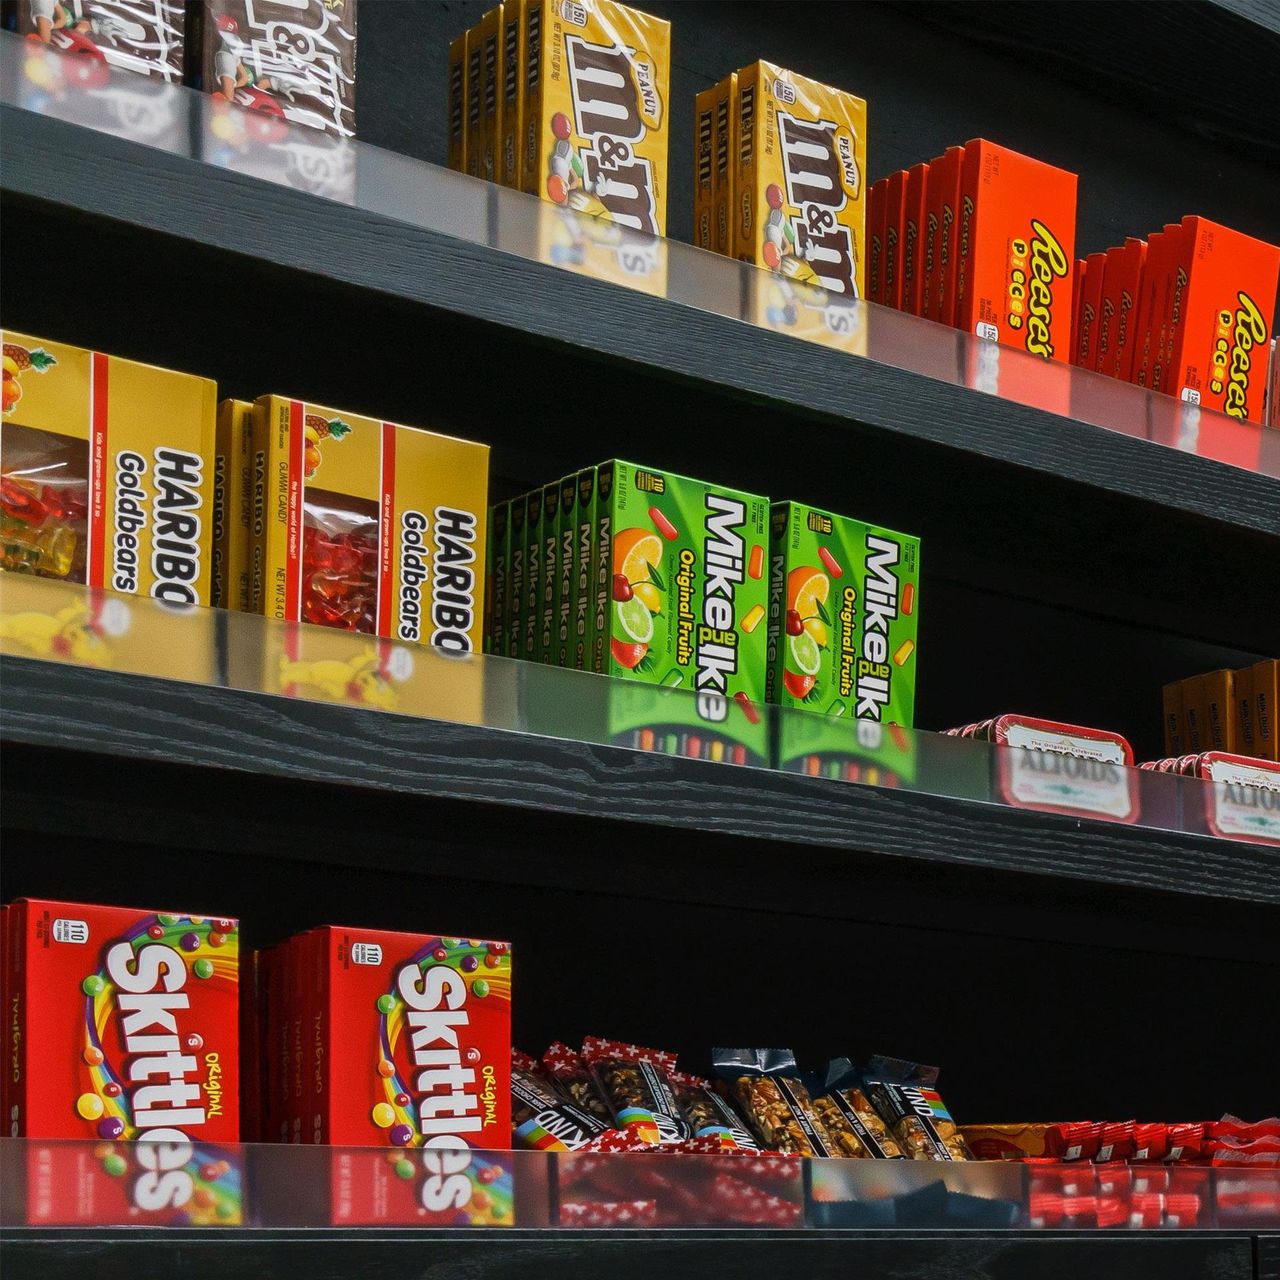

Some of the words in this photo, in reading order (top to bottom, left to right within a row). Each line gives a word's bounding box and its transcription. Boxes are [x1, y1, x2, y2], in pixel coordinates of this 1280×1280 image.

[638, 62, 656, 117] PEANUT
[839, 136, 857, 187] PEANUT
[1027, 219, 1068, 358] Reese's
[1224, 291, 1269, 423] Reese's
[279, 461, 288, 494] GUMMI
[651, 473, 664, 494] 110
[112, 450, 147, 594] Goldbears
[152, 447, 203, 614] HARIBO
[277, 494, 288, 525] CANDY
[398, 510, 429, 643] Goldbears
[431, 505, 477, 658] HARIBO
[676, 548, 697, 620] Original
[703, 495, 747, 631] Mike
[841, 585, 858, 652] Original
[863, 534, 901, 665] Mike
[675, 620, 696, 667] Fruits
[698, 627, 737, 648] and
[839, 652, 854, 697] Fruits
[859, 661, 890, 679] and
[1018, 745, 1121, 784] ALTOIDS
[1031, 740, 1042, 748] The
[1043, 742, 1070, 751] Original
[1071, 748, 1104, 758] Celebrated
[1231, 774, 1242, 782] The
[1243, 776, 1266, 785] Original
[70, 919, 85, 943] 110
[366, 945, 380, 965] 110
[105, 941, 207, 1212] Skittles
[397, 963, 483, 1213] Skittles
